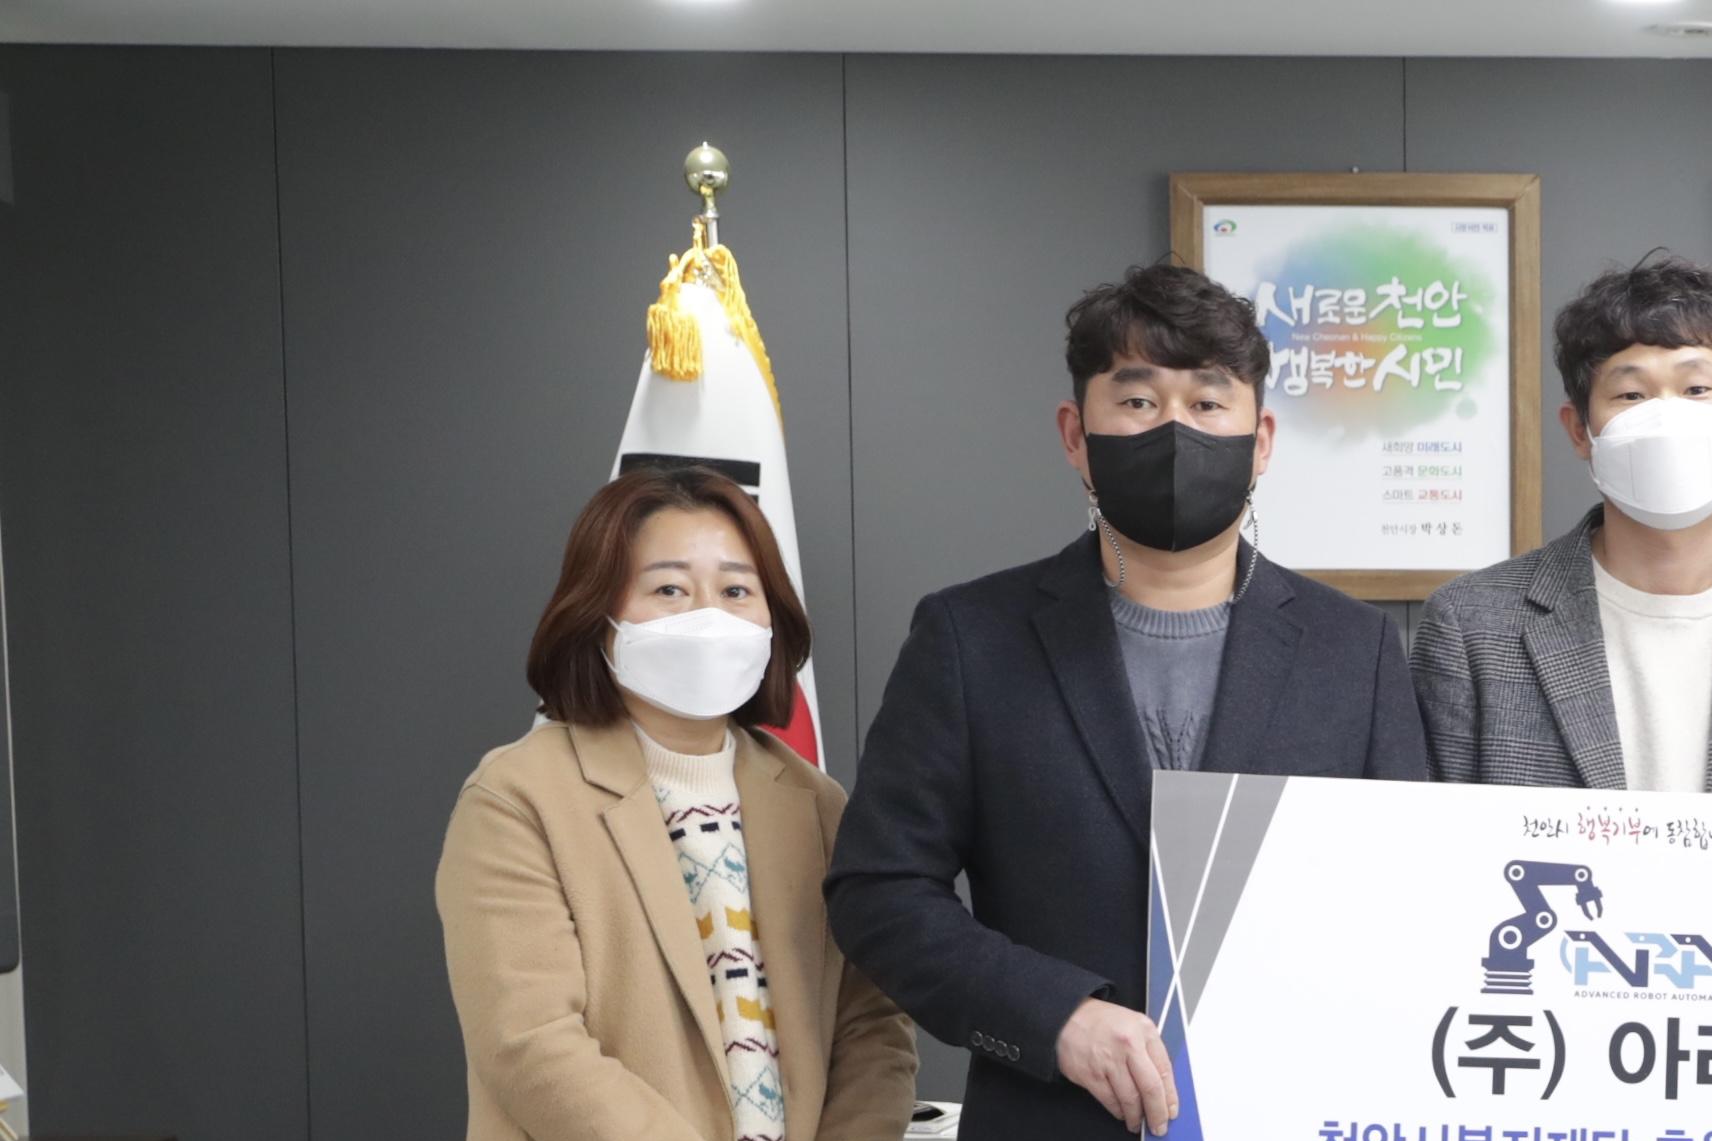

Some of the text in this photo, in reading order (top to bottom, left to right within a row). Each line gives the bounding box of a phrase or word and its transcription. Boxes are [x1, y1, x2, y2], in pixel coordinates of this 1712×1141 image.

[1255, 277, 1468, 328] 새로운 천안
[1266, 342, 1463, 396] 행복한 시민
[1416, 441, 1463, 453] 미래도시
[1417, 465, 1463, 477] 문화도시
[1417, 489, 1463, 501] 교통도시
[1522, 815, 1569, 838] 천안시
[1577, 811, 1659, 845] 행복기부에
[1574, 990, 1630, 999] ADVANCED
[1633, 992, 1668, 1000] ROBOT
[1431, 1006, 1566, 1100] (주)
